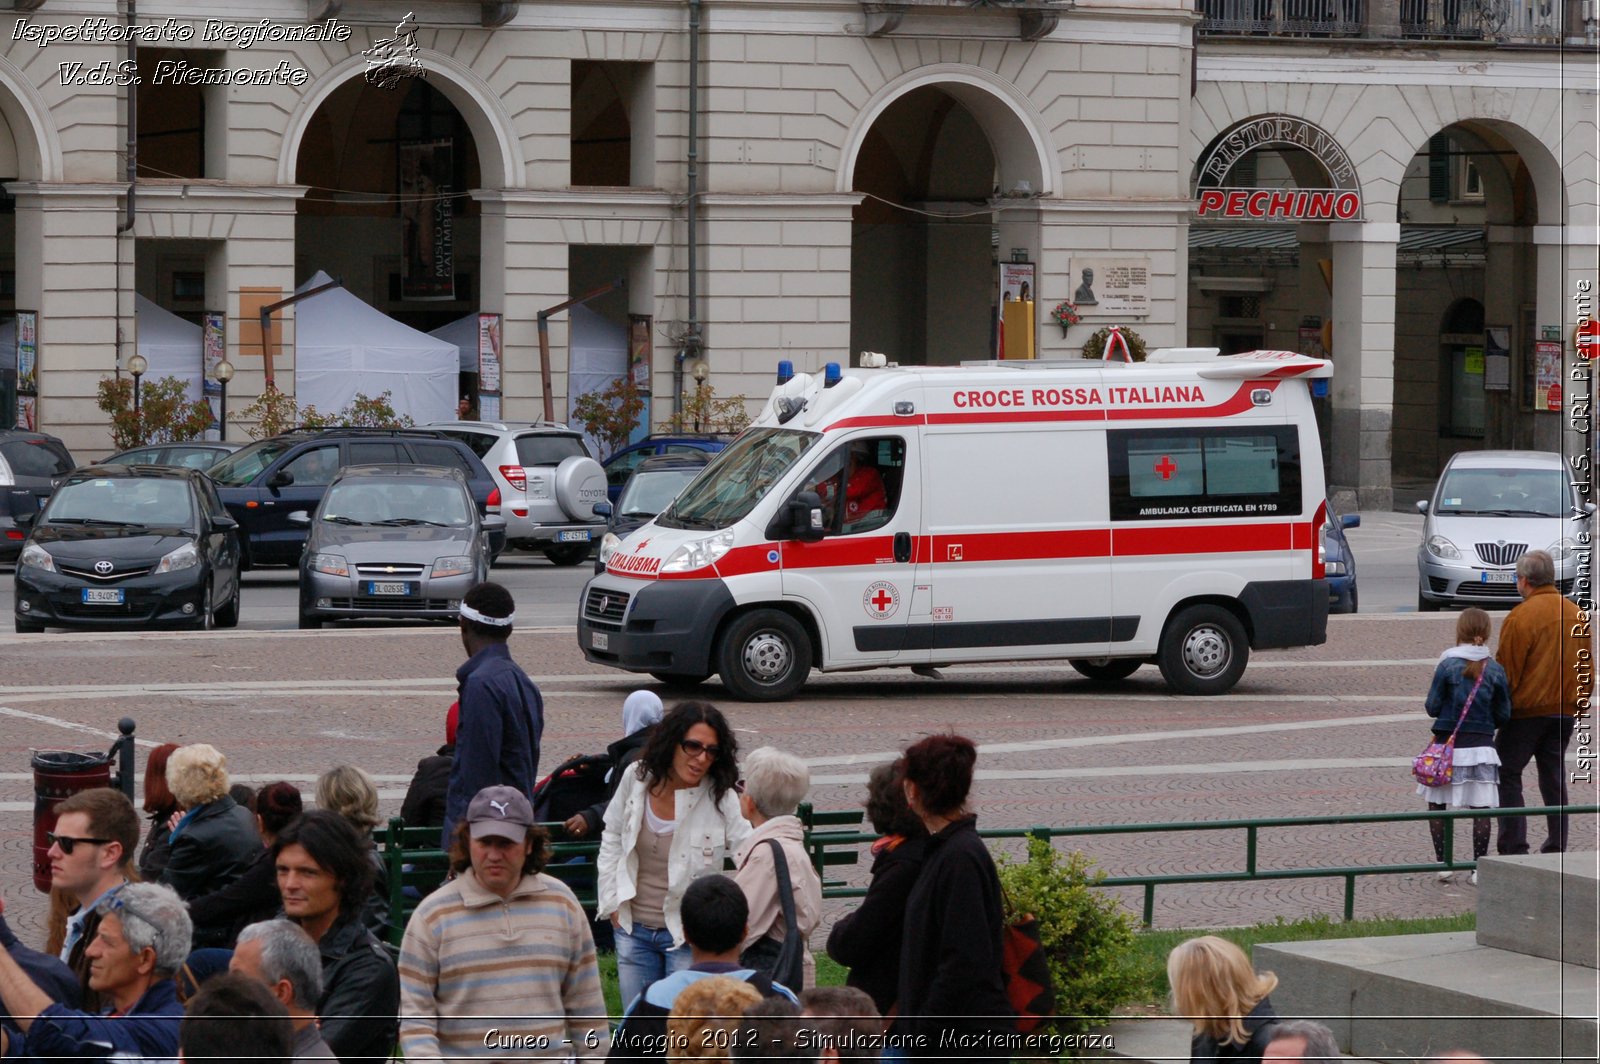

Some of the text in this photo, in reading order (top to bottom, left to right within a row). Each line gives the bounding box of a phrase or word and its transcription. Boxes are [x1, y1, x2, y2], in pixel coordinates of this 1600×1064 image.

[1206, 119, 1353, 183] RISTORANTE
[1197, 190, 1360, 219] PECHINO
[435, 227, 443, 277] MUSEO
[953, 386, 1205, 408] CROCE ROSSA ITALIANA
[580, 489, 606, 498] TOYOTA
[1139, 507, 1190, 515] AMBULANZA
[1191, 504, 1243, 513] CERTIFICATA
[1259, 503, 1277, 511] 1789
